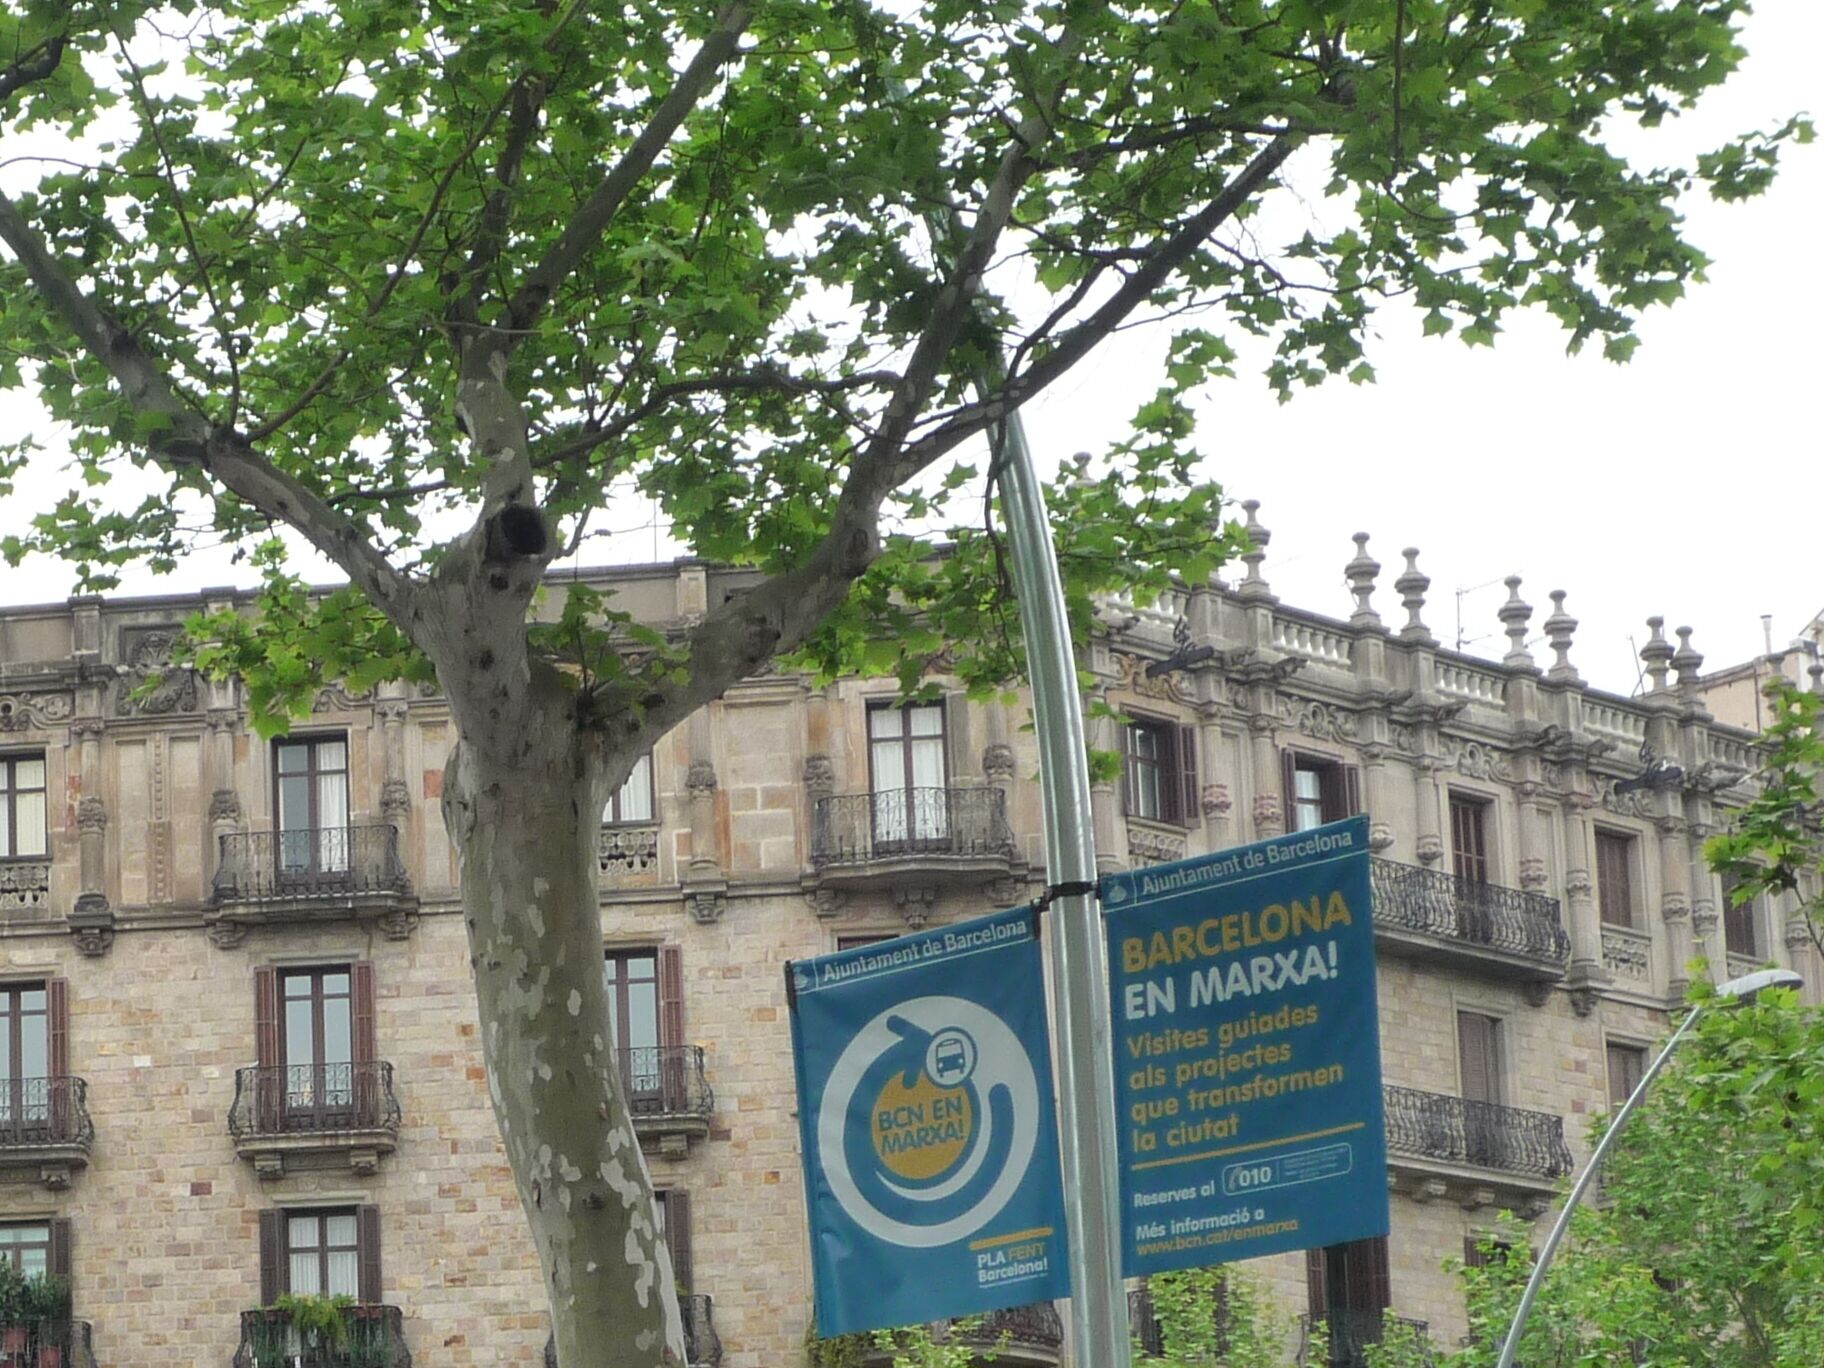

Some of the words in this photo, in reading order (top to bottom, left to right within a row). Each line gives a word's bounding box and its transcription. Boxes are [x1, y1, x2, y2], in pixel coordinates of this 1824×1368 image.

[1143, 855, 1241, 896] Ajuntament
[1245, 850, 1264, 870] de
[1267, 831, 1353, 864] Barcelona
[823, 945, 920, 981] Ajuntament
[923, 938, 943, 957] de
[944, 918, 1027, 952] Barcelona
[1122, 890, 1352, 973] BARCELONA
[1125, 976, 1175, 1020] EN
[1189, 940, 1338, 1008] MARXA!
[1128, 1028, 1209, 1058] Visites
[1218, 1004, 1319, 1048] guiades
[1129, 1063, 1166, 1090] als
[1176, 1043, 1292, 1088] projectes
[878, 1104, 924, 1132] BCN
[933, 1096, 964, 1120] EN
[1131, 1097, 1179, 1126] que
[1187, 1062, 1344, 1112] transformen
[880, 1119, 966, 1156] MARXA!
[1132, 1128, 1157, 1152] la
[1166, 1112, 1240, 1147] ciutat
[1133, 1186, 1197, 1208] Reserves
[1200, 1180, 1215, 1196] al
[1239, 1166, 1272, 1187] 010
[1135, 1222, 1166, 1240] Més
[1171, 1206, 1250, 1234] informació
[1254, 1208, 1265, 1220] a
[1136, 1219, 1300, 1255] www.bcn.cat/enmarxa
[977, 1251, 1007, 1268] PLA
[978, 1258, 1049, 1283] Barcelona!
